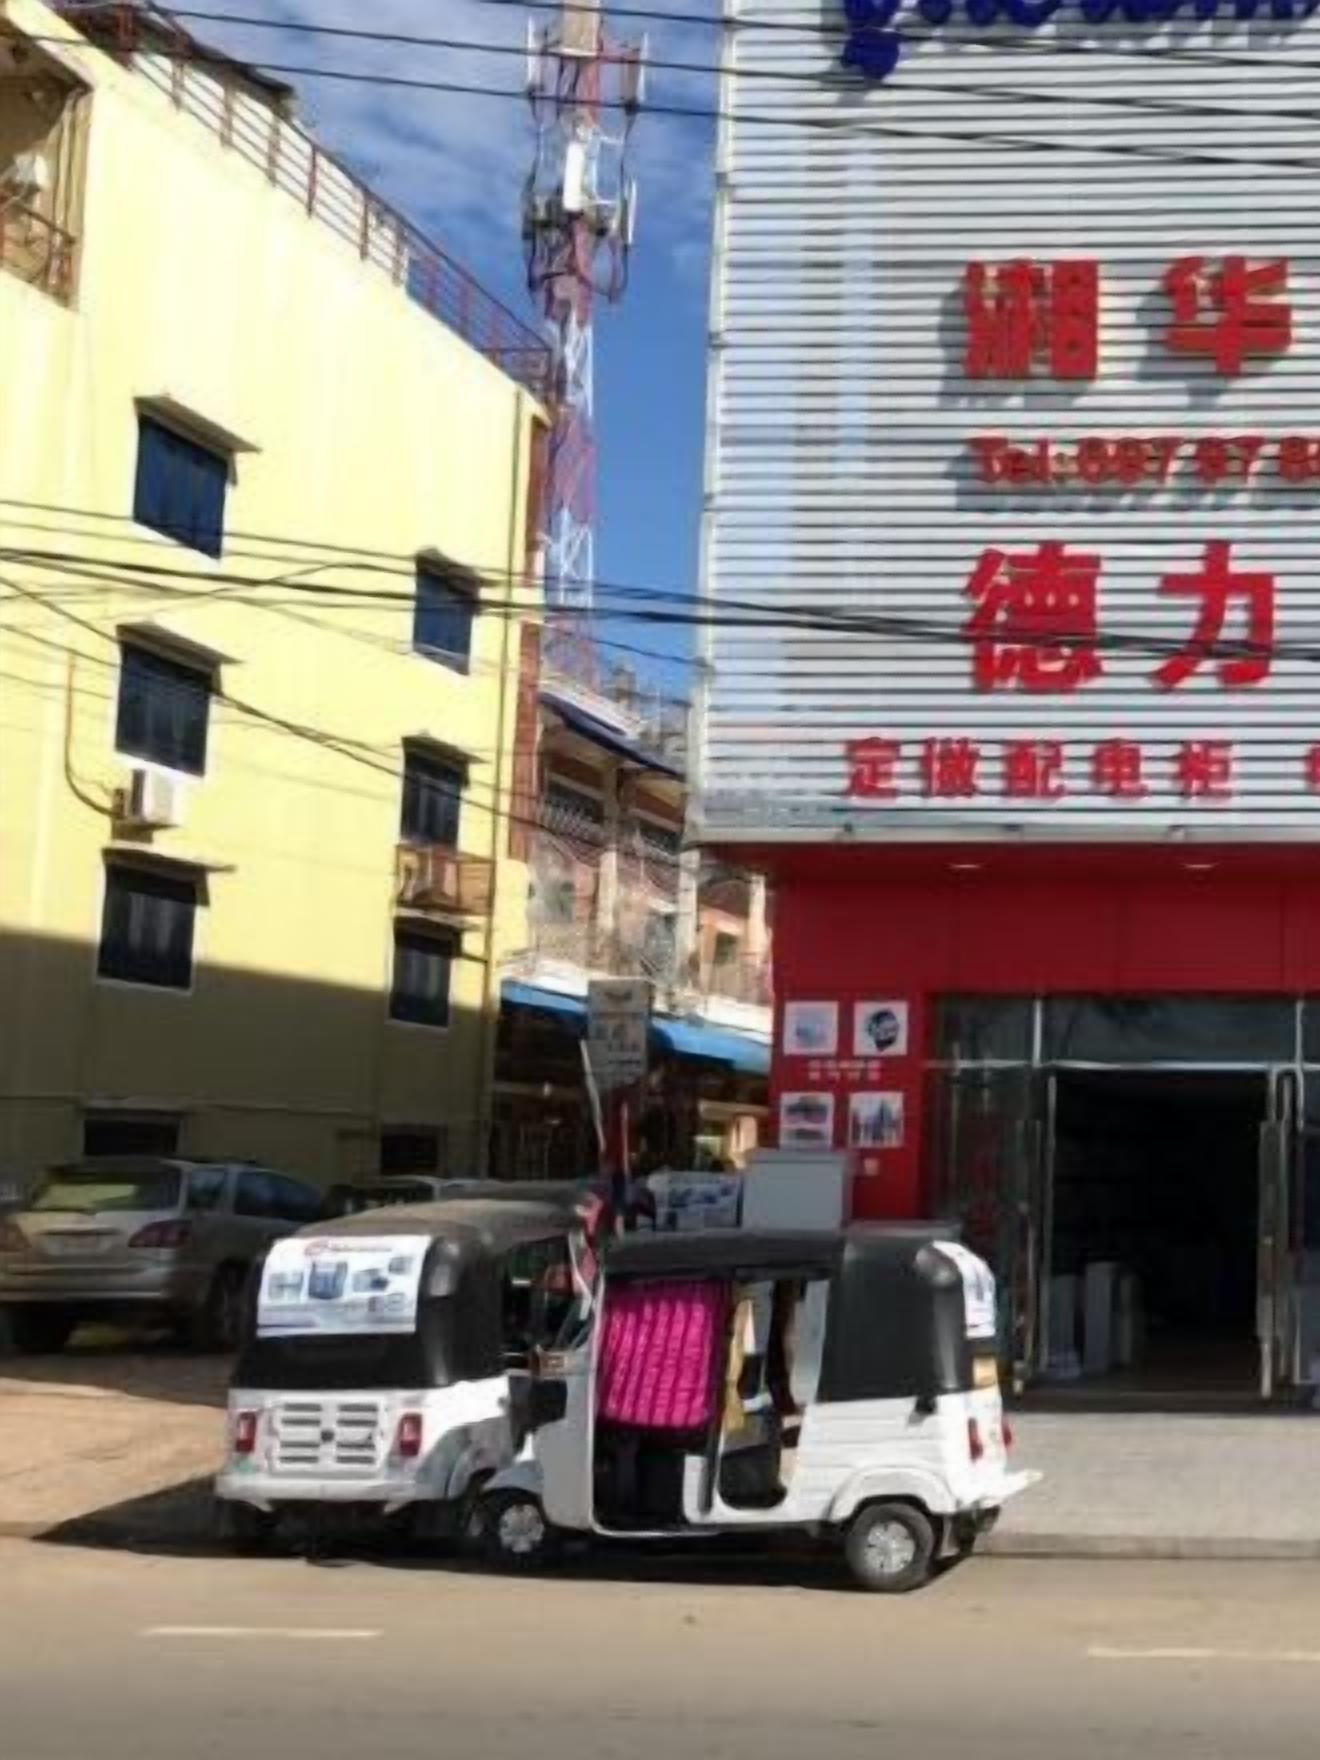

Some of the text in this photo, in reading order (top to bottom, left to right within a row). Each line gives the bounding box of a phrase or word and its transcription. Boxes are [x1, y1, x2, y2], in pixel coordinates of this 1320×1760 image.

[847, 738, 1232, 798] 定做配电柜
